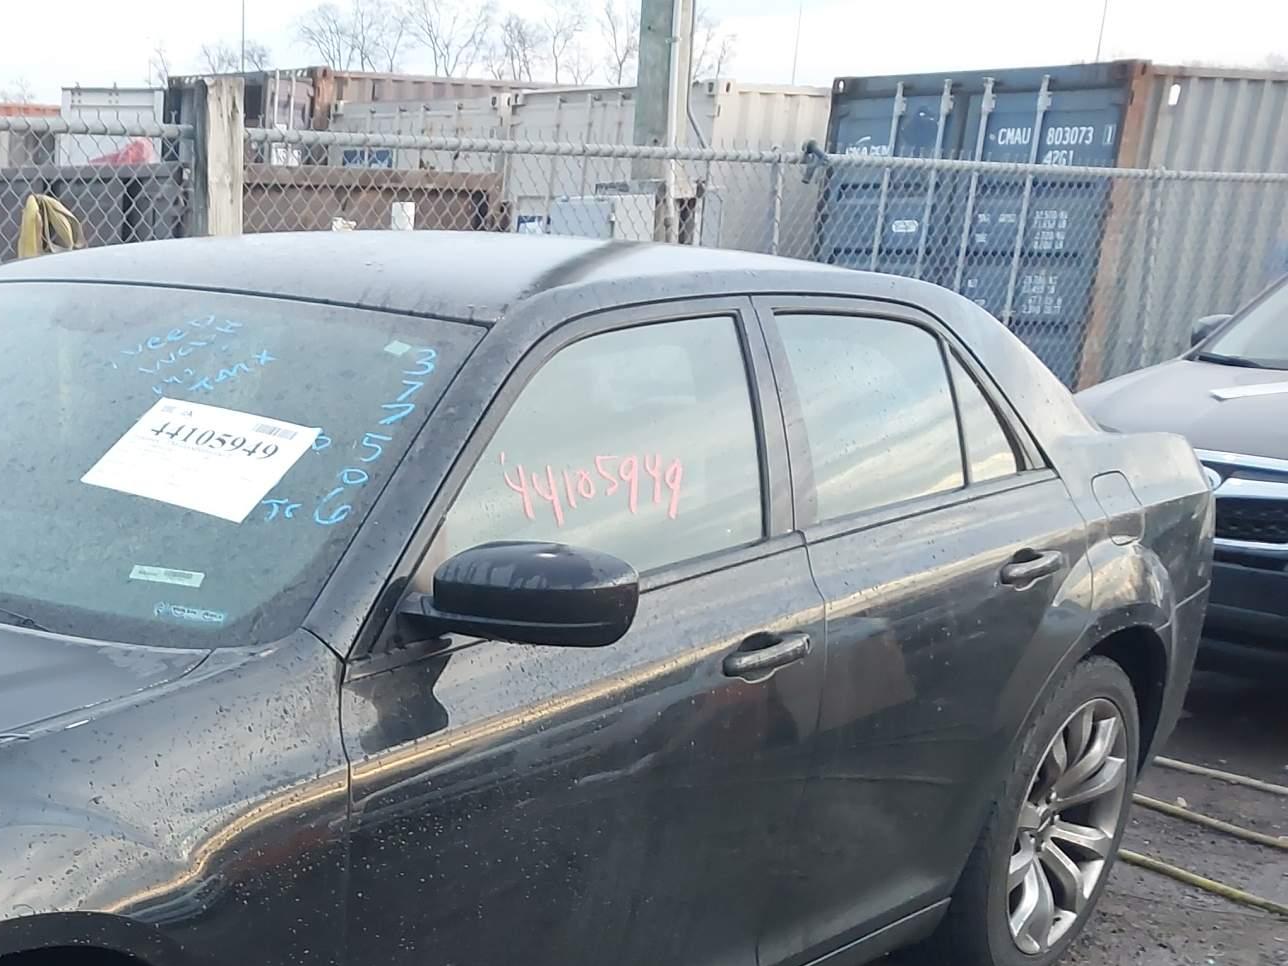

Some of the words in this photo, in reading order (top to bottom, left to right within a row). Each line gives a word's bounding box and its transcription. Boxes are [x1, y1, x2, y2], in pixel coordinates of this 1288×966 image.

[997, 126, 1031, 145] CMAU
[1046, 126, 1094, 145] 803073
[150, 419, 280, 460] 44105949
[499, 451, 684, 528] 44105949
